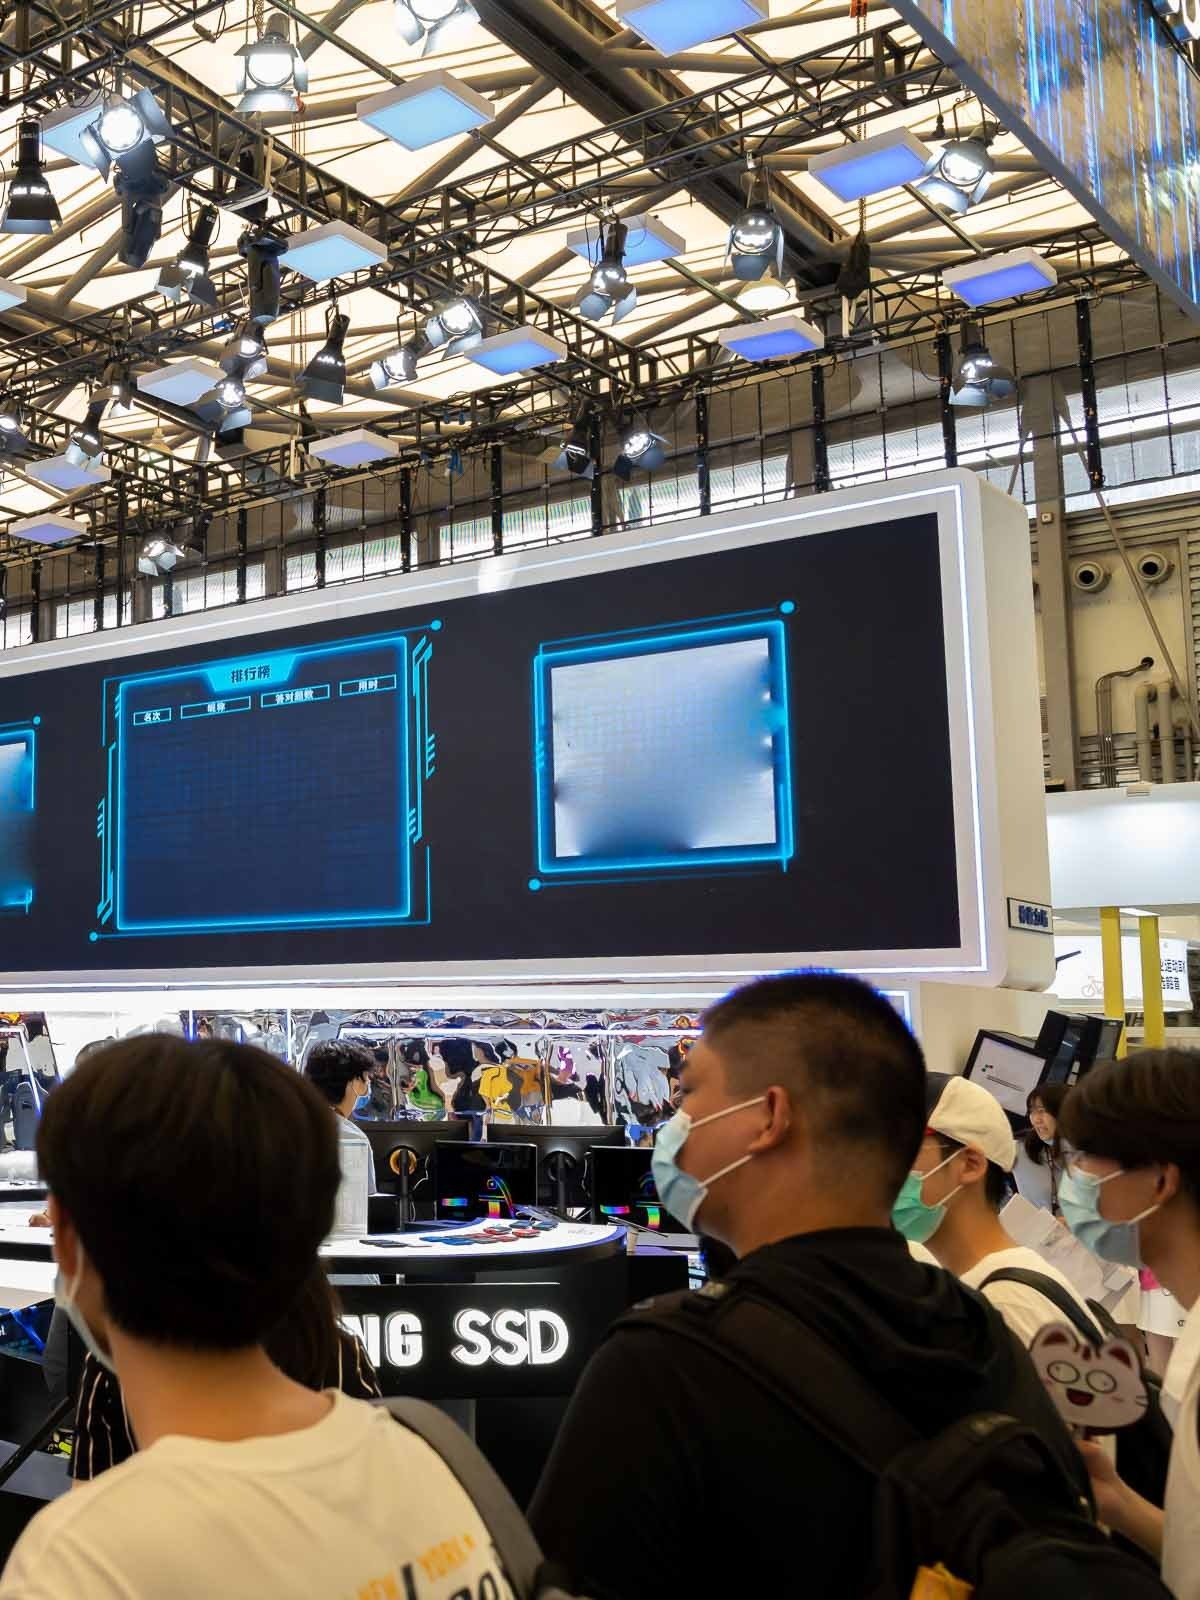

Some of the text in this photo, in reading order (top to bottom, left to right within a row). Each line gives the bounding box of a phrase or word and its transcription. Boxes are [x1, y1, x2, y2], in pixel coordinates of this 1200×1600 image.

[231, 664, 271, 684] 排行榜
[143, 711, 161, 722] 名次
[452, 1308, 569, 1366] SSD
